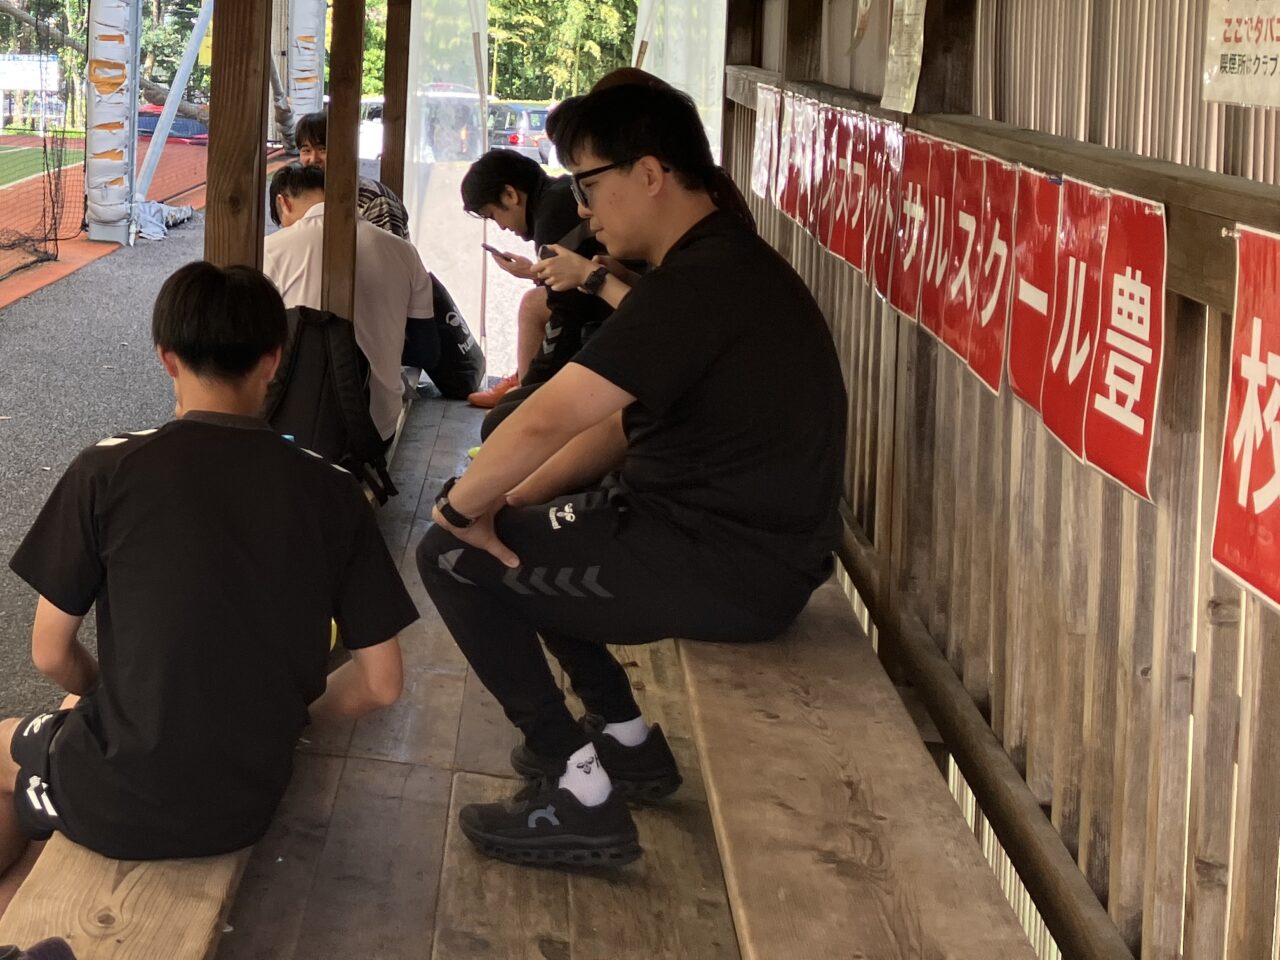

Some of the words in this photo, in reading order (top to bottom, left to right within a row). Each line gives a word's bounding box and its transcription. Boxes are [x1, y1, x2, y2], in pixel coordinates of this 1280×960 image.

[1220, 53, 1280, 76] 喫煙所はクラブ
